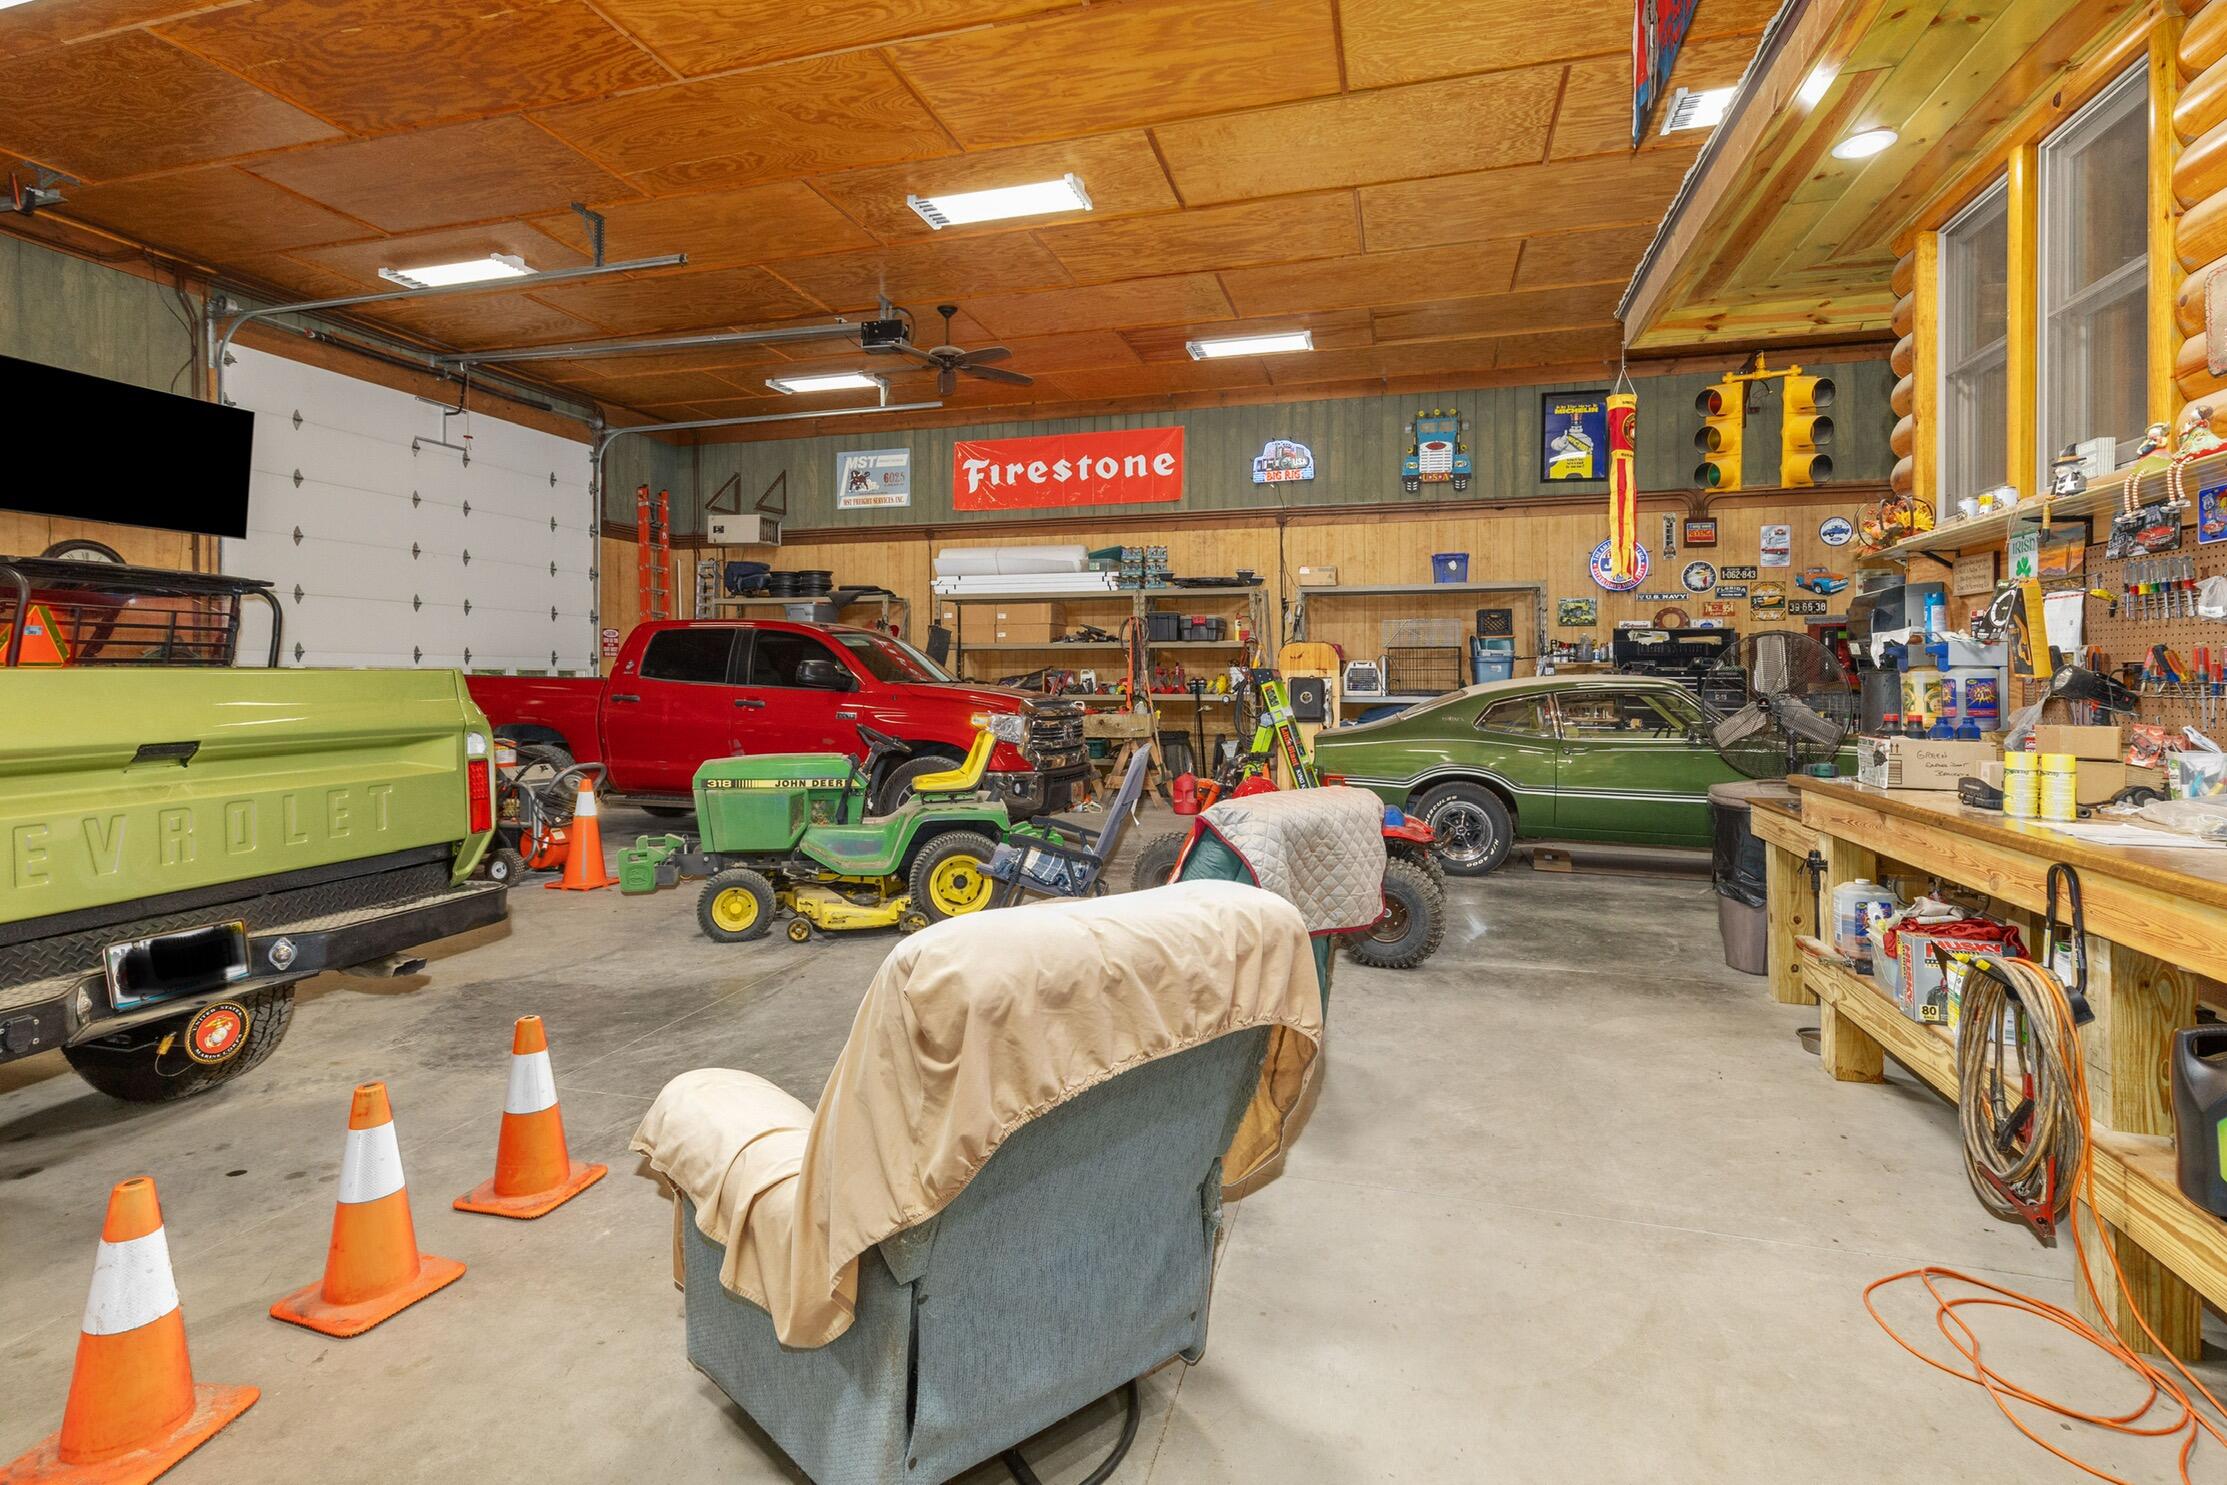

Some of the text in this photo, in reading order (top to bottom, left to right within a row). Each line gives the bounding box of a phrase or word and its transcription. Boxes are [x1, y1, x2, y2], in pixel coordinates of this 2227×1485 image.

[847, 456, 877, 469] MST
[962, 452, 1176, 494] Firestone
[1266, 469, 1301, 481] BIG RIG
[853, 497, 872, 506] FREIGHT
[2012, 538, 2036, 555] IRISH
[1722, 570, 1756, 579] 1-062-843
[707, 779, 732, 788] 318
[775, 779, 806, 787] JOHN
[1424, 795, 1458, 825] HERCULES
[1466, 856, 1489, 867] 4000
[1921, 1005, 1937, 1015] 80
[192, 1005, 243, 1031] UNITED STATES
[195, 1033, 243, 1059] MARINE CORPS
